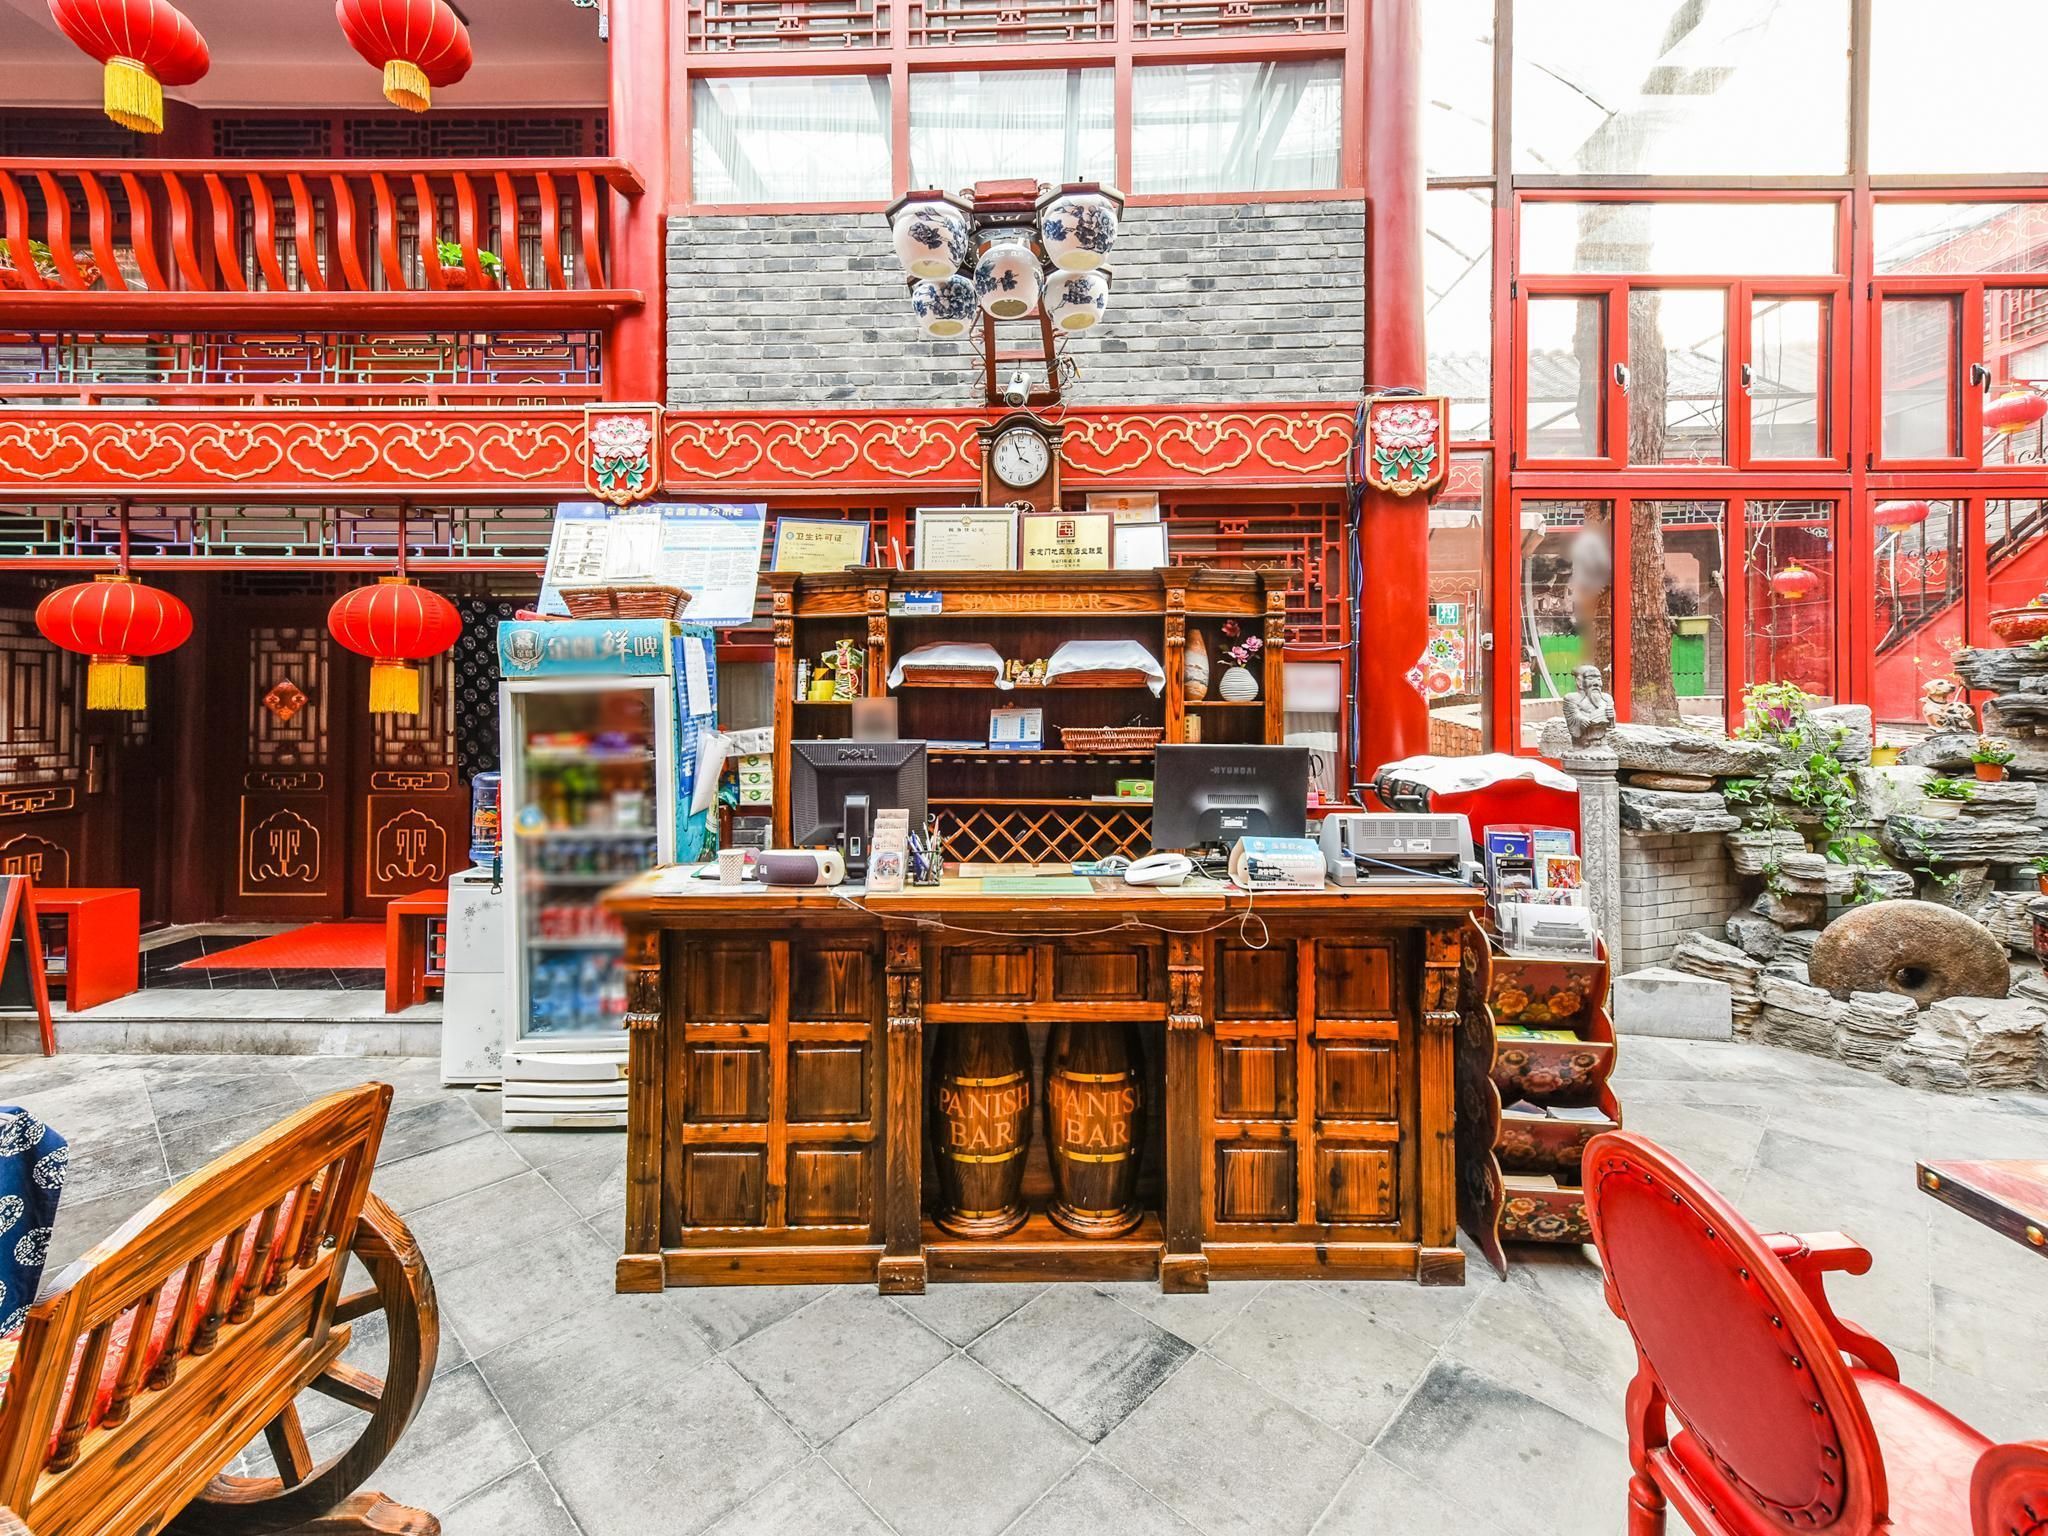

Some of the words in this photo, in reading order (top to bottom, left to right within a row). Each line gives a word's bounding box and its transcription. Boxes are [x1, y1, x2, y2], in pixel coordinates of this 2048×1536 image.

[795, 532, 842, 542] 卫生许可证
[961, 593, 1046, 610] SPANISH
[1058, 593, 1103, 610] BAR
[838, 748, 878, 761] DELL
[1210, 766, 1256, 774] HYUNDAI
[938, 1081, 1030, 1119] PANISH
[950, 1120, 1014, 1150] BAR
[1066, 1118, 1129, 1148] BAR
